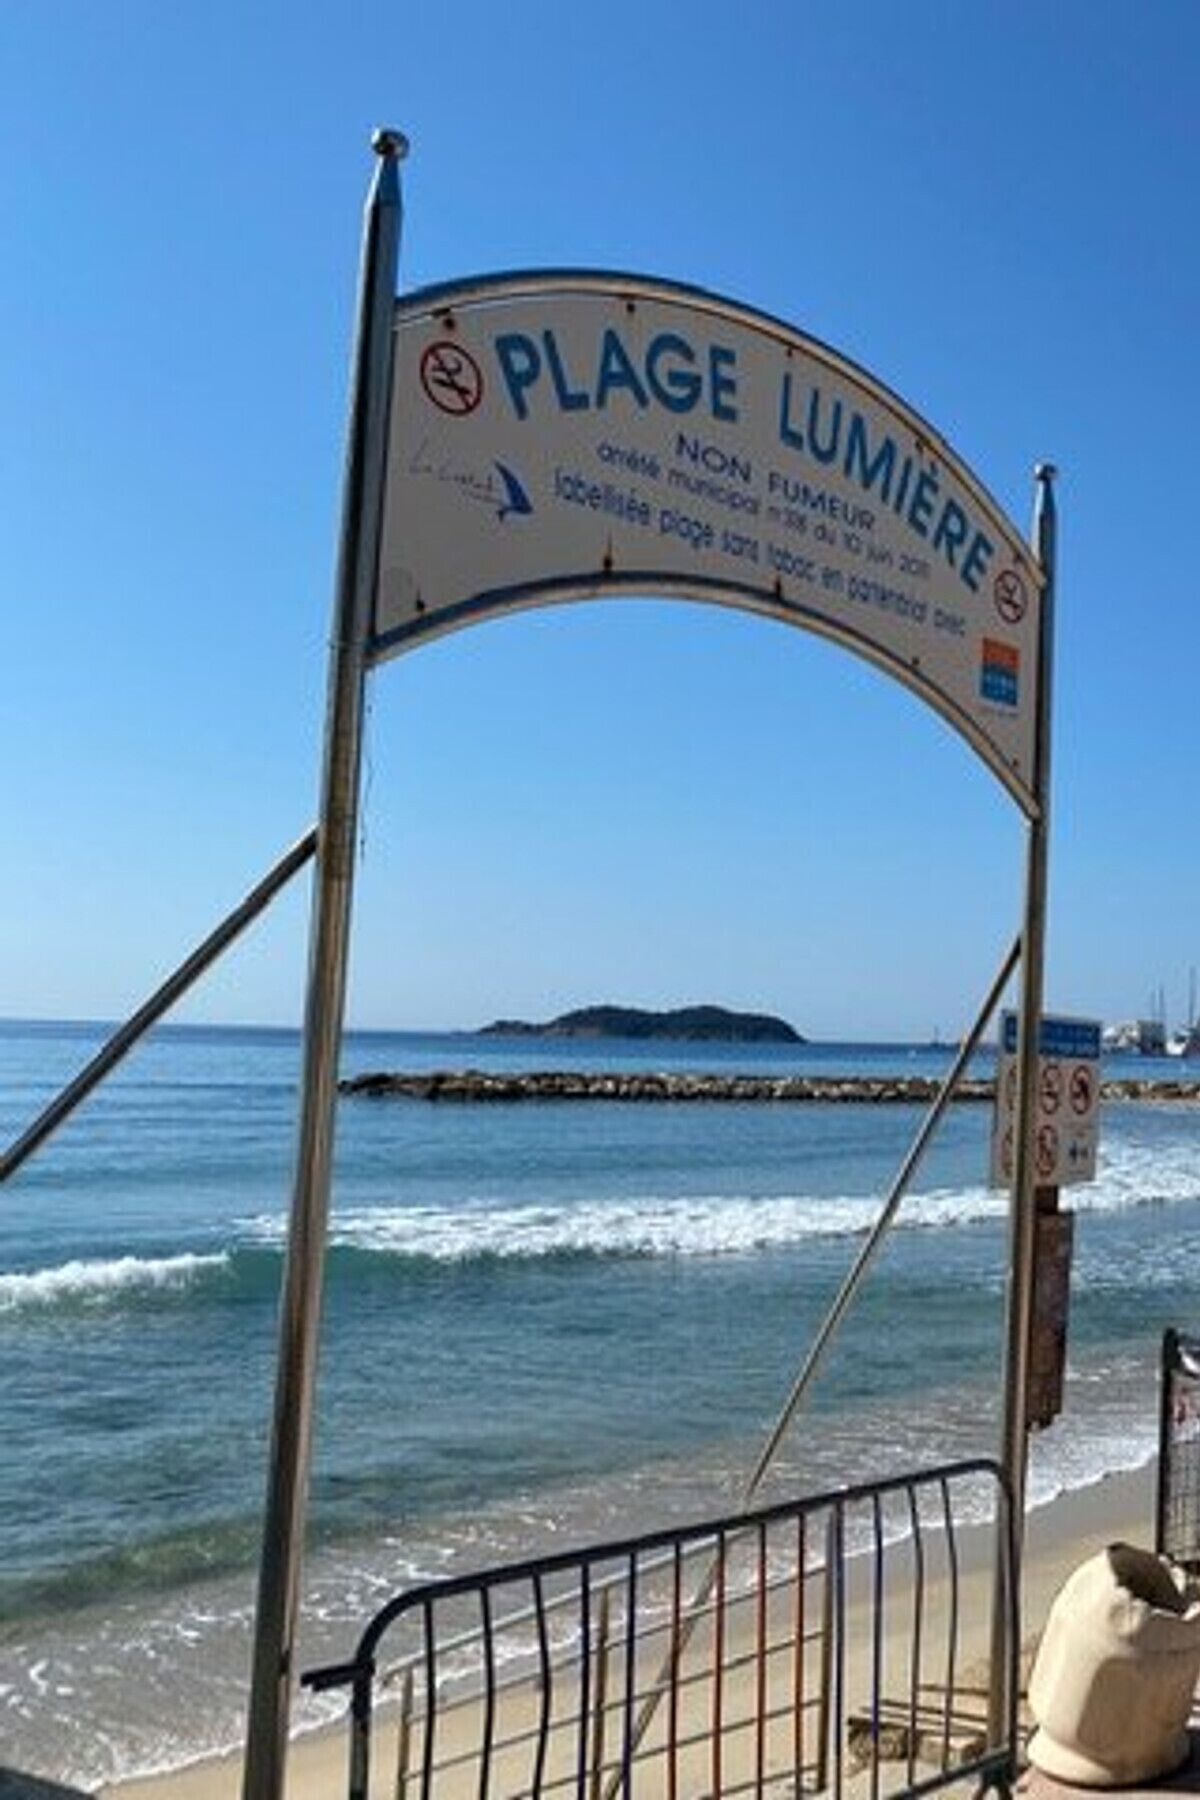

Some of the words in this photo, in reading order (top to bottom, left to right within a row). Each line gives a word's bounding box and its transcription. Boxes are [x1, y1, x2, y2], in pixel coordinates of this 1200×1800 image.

[495, 328, 737, 421] PLAGE
[780, 372, 993, 592] LUMIÈRE
[676, 432, 751, 482] NON
[768, 472, 875, 530] FUMEUR
[660, 508, 714, 549] plage
